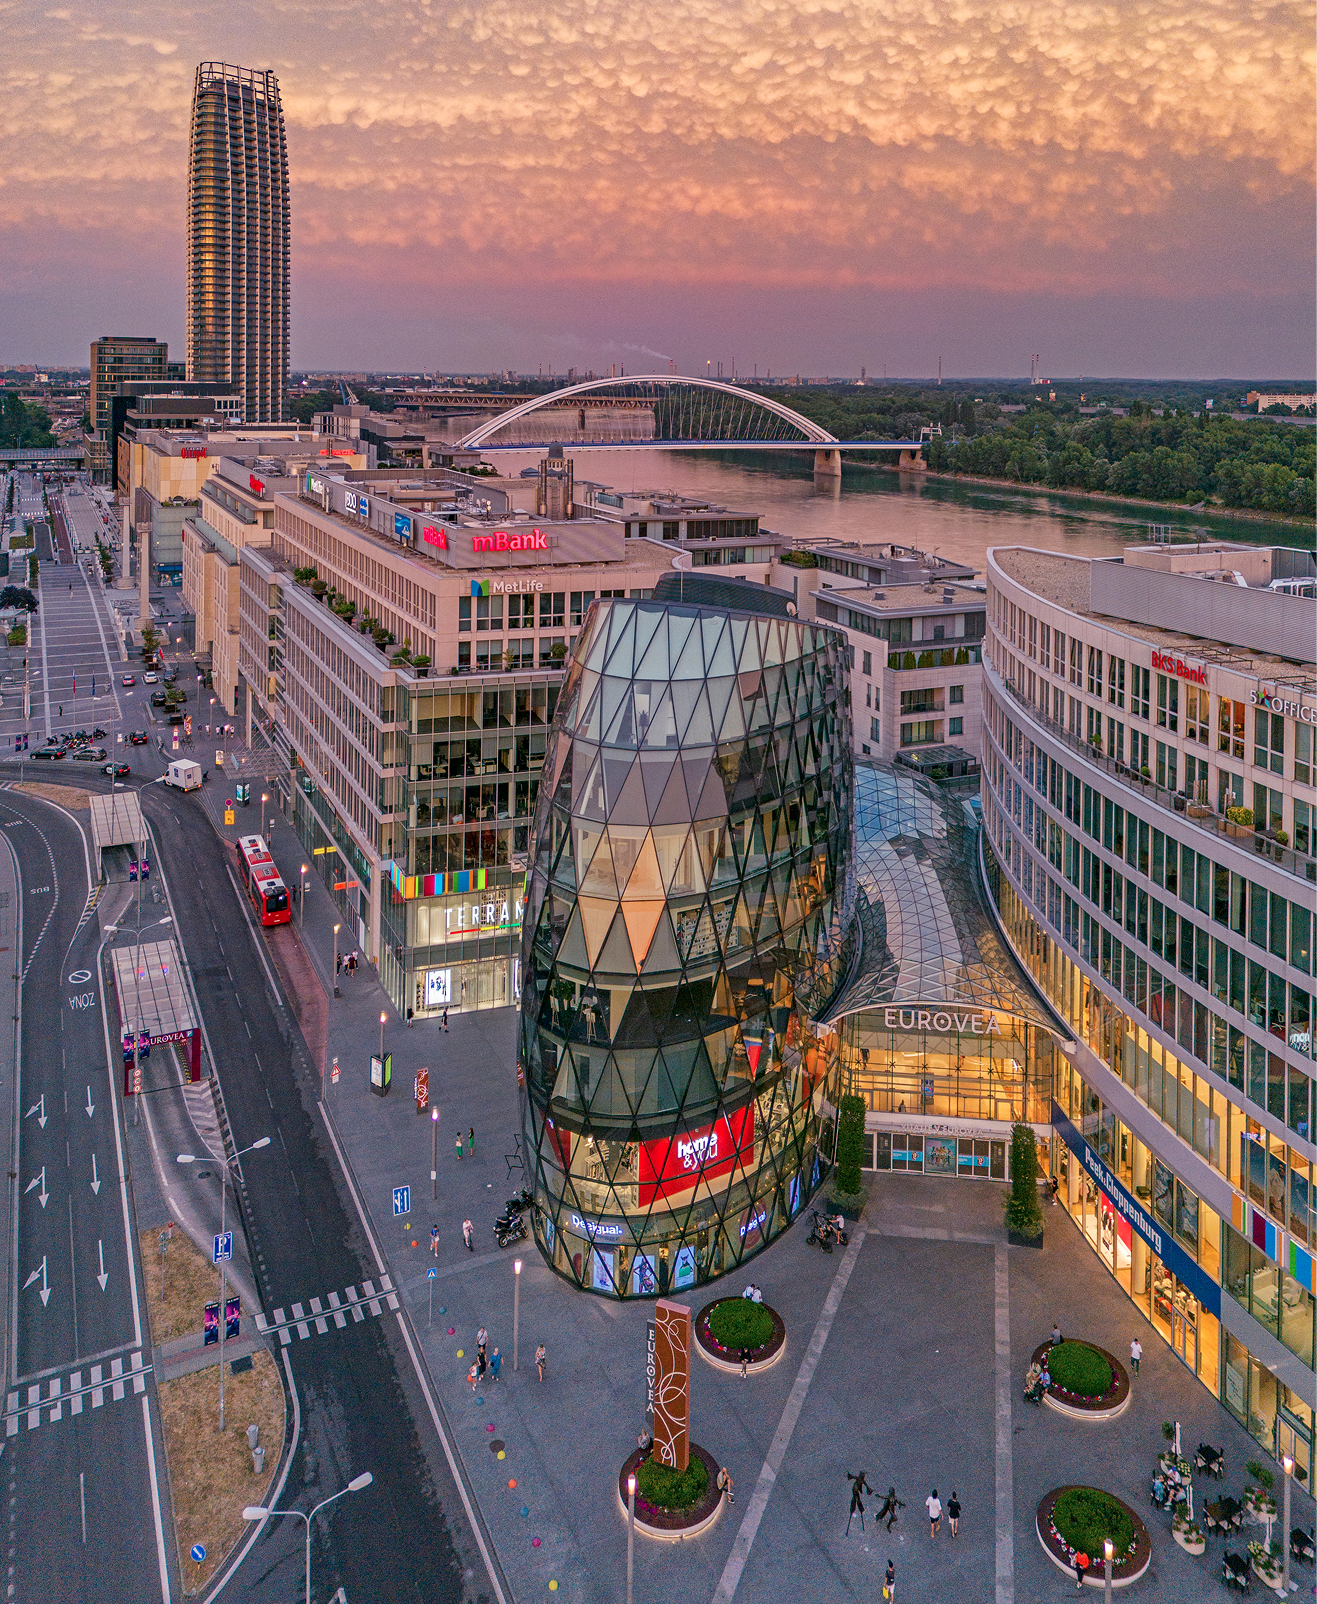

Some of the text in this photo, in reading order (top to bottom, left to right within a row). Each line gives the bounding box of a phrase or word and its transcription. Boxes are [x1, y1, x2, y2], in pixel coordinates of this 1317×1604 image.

[423, 525, 447, 550] mBank
[472, 529, 548, 552] mBank
[493, 580, 543, 593] MetLife
[1152, 651, 1206, 685] BKS Bank
[1271, 697, 1317, 723] OFFICE
[31, 886, 50, 894] BUS
[69, 992, 95, 1010] ZÓNA
[884, 1008, 1002, 1035] EUROVEA
[150, 1032, 184, 1045] UROVEA
[943, 1125, 984, 1136] EUROVEA
[677, 1133, 718, 1158] home
[646, 1329, 656, 1414] EUROVEA
